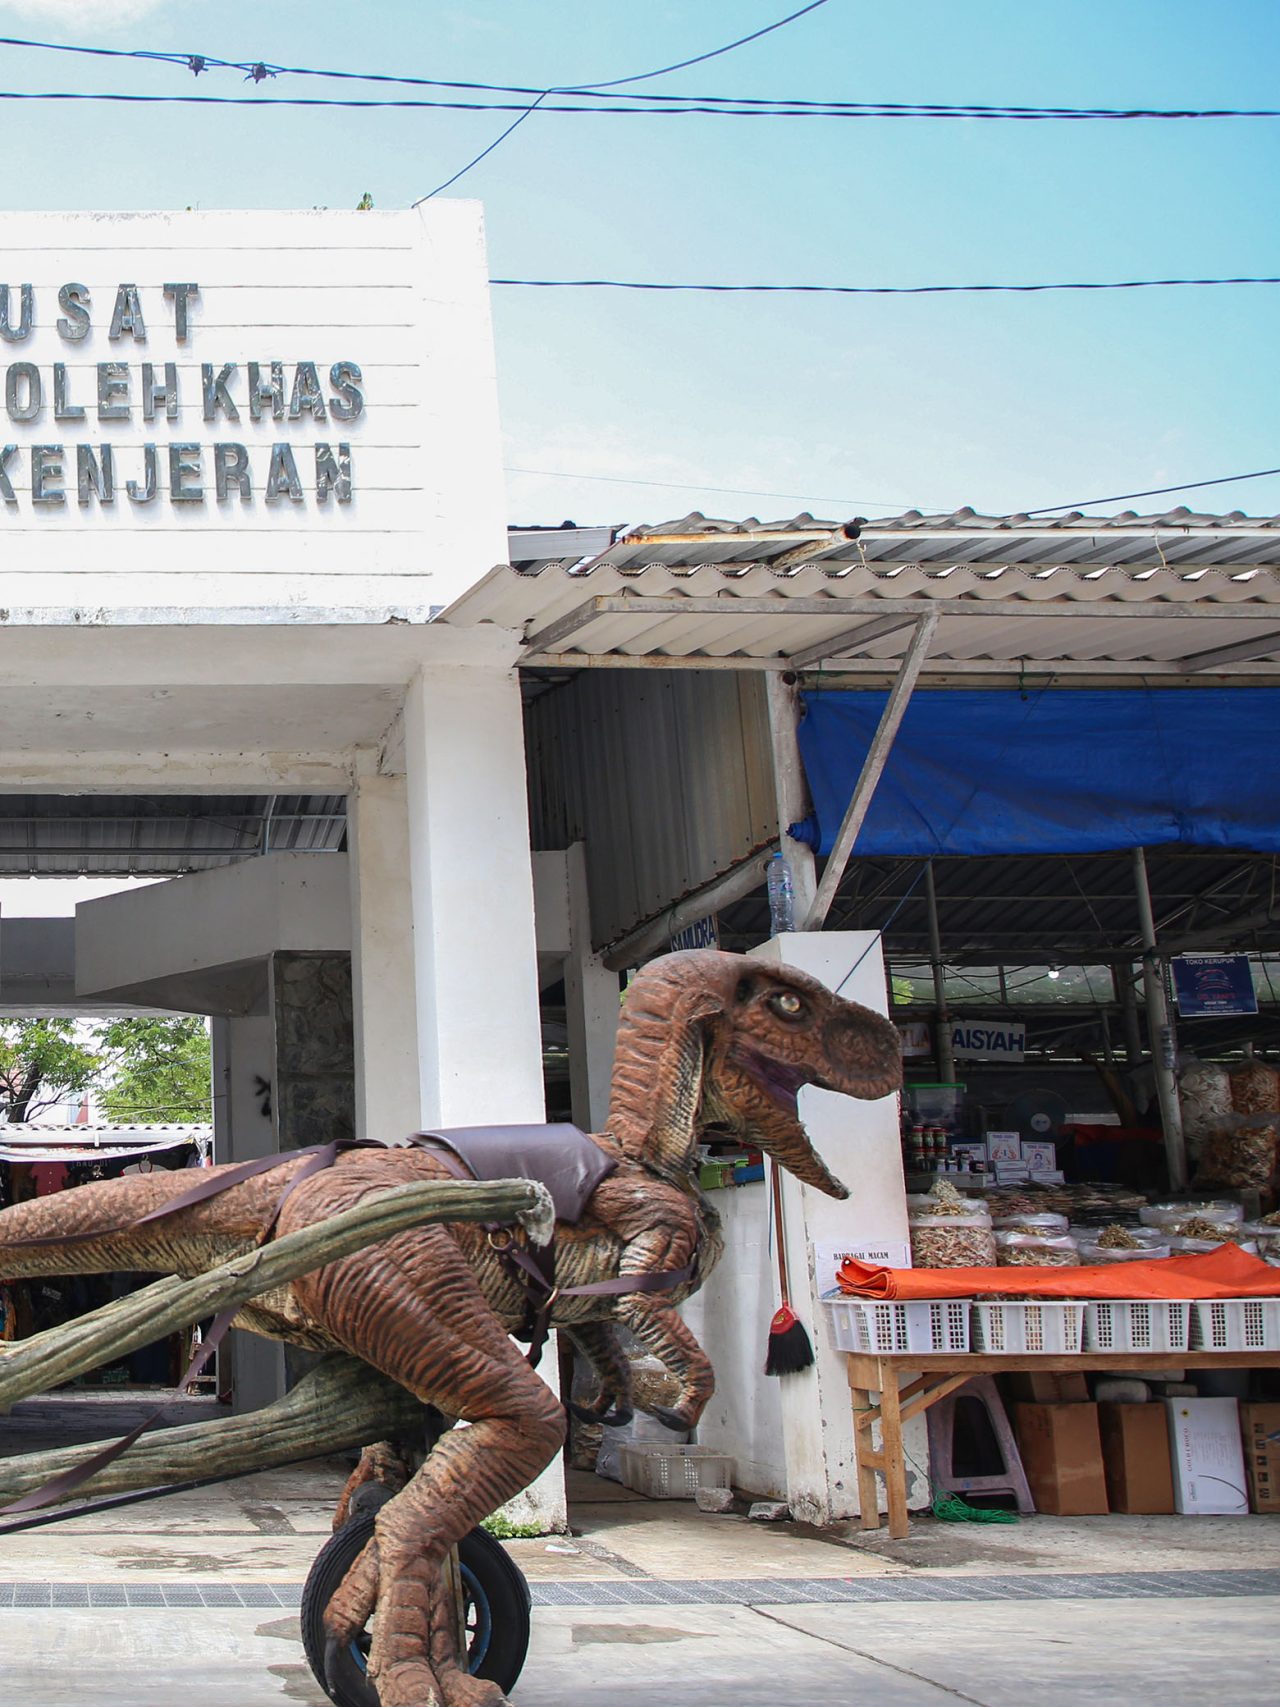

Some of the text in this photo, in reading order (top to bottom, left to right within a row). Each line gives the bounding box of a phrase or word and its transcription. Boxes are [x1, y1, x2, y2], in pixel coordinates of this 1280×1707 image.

[201, 361, 364, 422] KHAS
[951, 1028, 1024, 1051] AISYAH
[868, 1251, 889, 1259] MACAM
